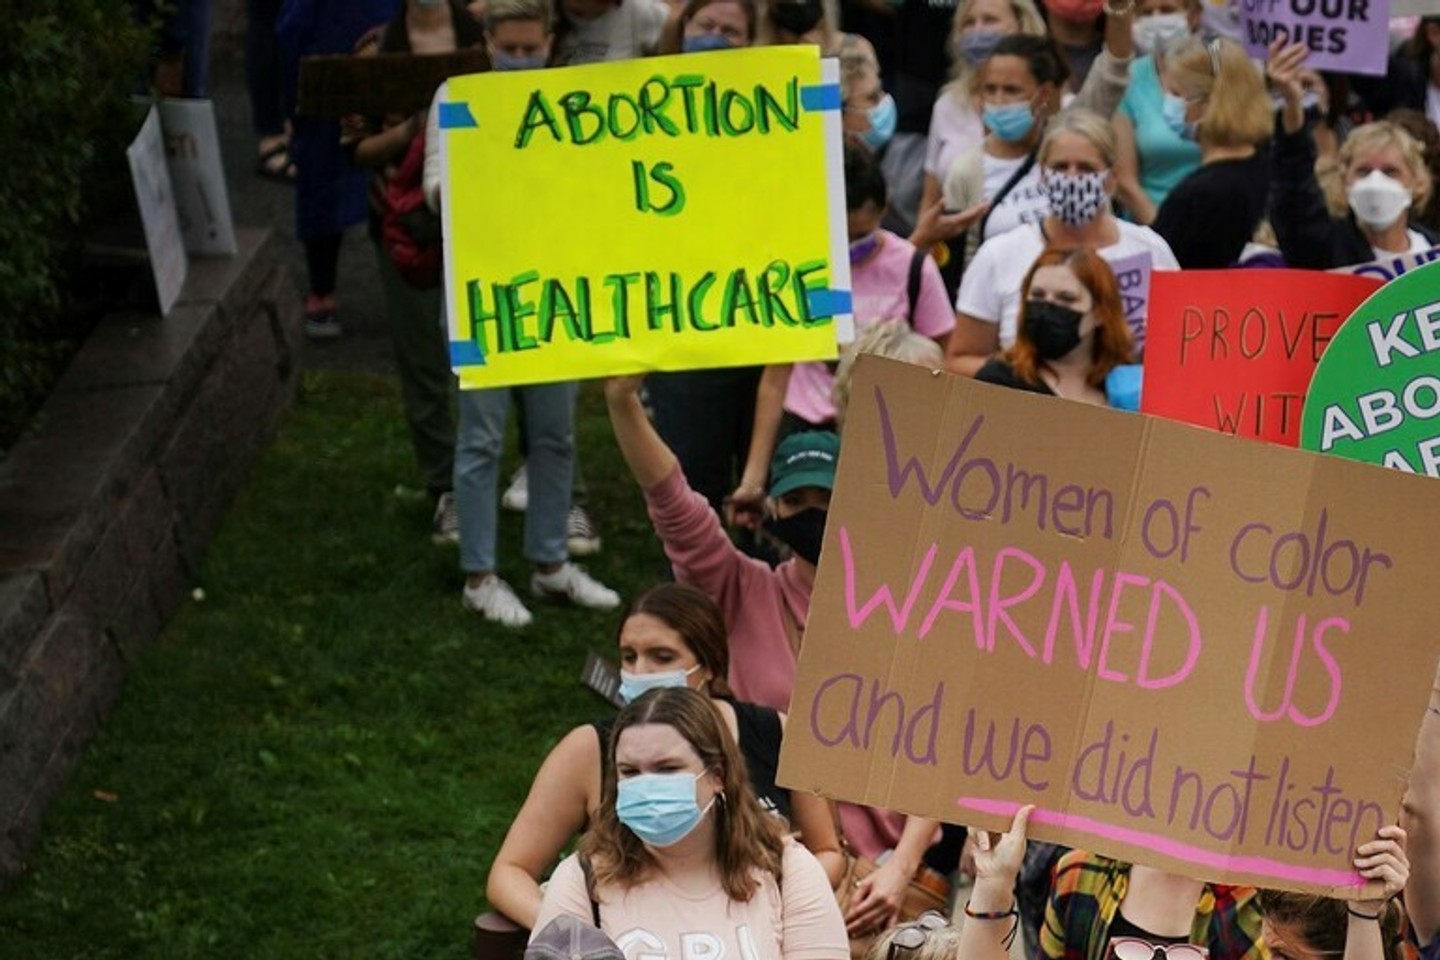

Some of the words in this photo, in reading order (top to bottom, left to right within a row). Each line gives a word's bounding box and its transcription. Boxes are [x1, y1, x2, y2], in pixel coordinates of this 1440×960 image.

[514, 74, 800, 150] ABORTION
[632, 159, 686, 217] IS
[466, 258, 833, 355] HEALTHCARE
[1179, 306, 1340, 366] PROVE
[1212, 392, 1303, 435] WIT
[873, 384, 1115, 542] Women
[1140, 485, 1213, 564] of
[1228, 506, 1394, 607] color
[839, 525, 1202, 691] WARNED
[1243, 605, 1351, 728] US
[808, 671, 945, 768] and
[960, 706, 1053, 792] we
[1071, 719, 1160, 821] did
[1167, 753, 1273, 845] not
[1265, 755, 1386, 861] listen
